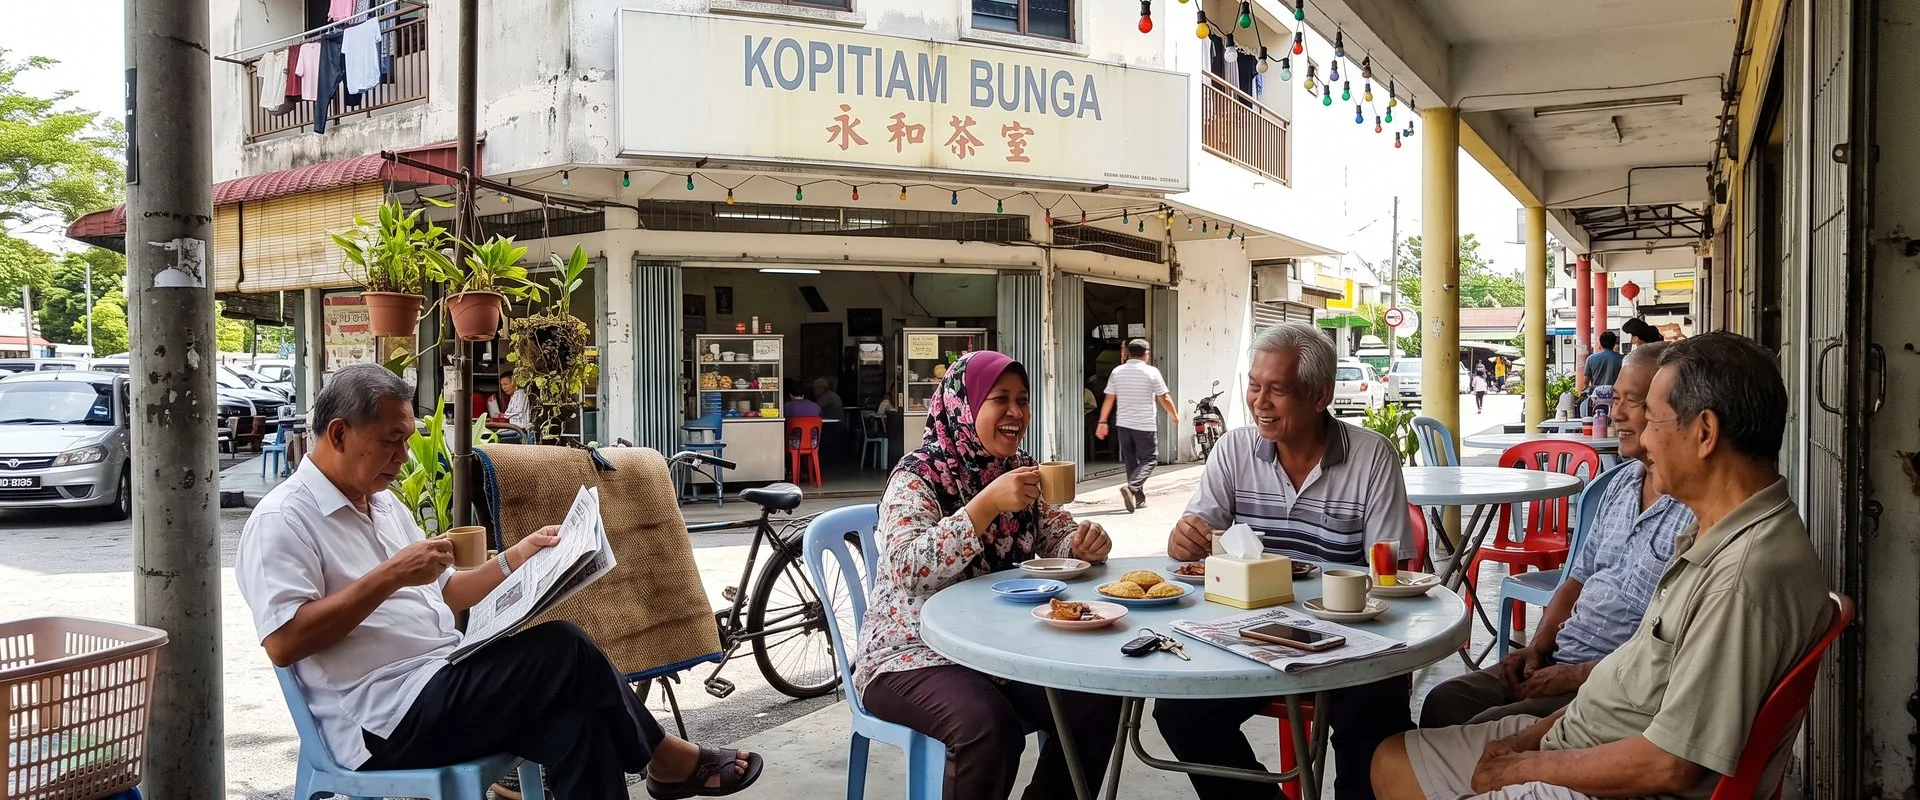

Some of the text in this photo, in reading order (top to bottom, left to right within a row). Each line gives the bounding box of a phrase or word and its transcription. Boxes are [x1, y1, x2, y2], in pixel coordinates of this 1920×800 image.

[743, 35, 1102, 121] KOPITIAM BUNGA
[826, 104, 1035, 163] 永和茶室
